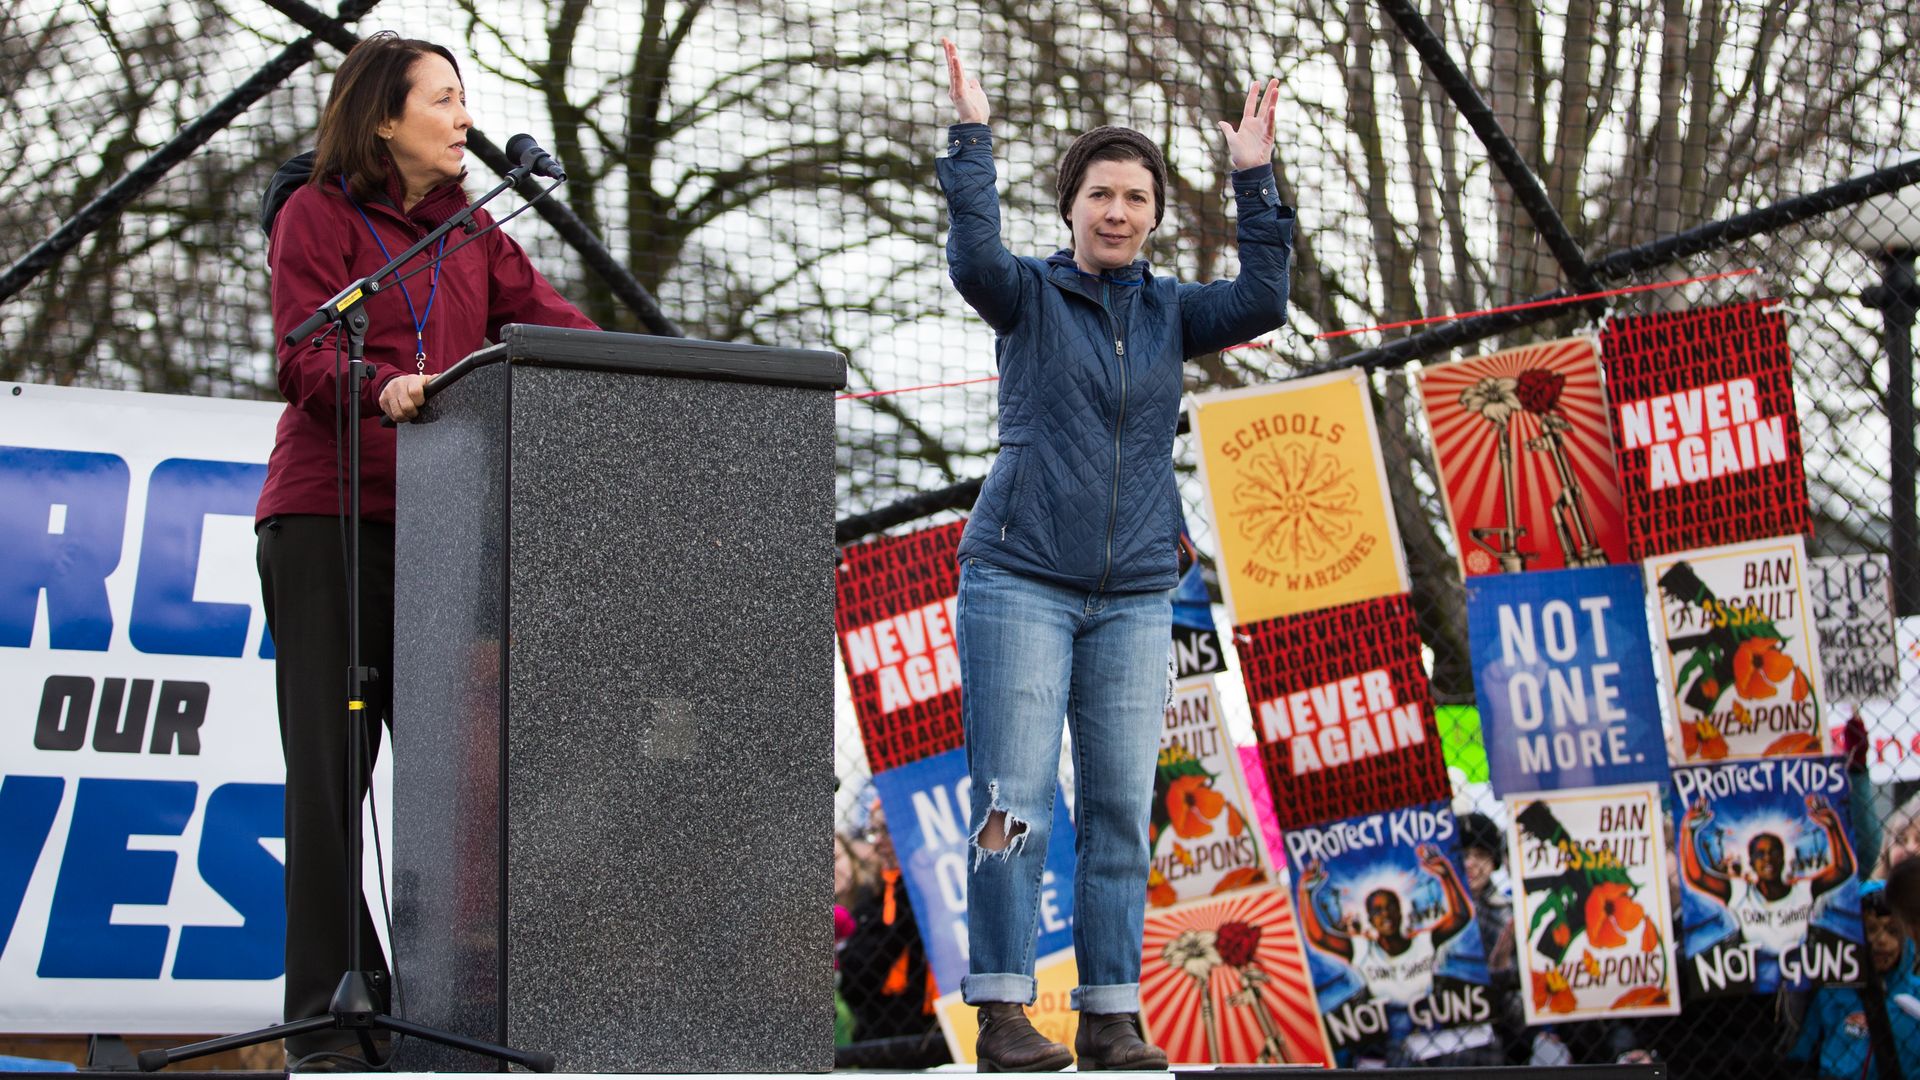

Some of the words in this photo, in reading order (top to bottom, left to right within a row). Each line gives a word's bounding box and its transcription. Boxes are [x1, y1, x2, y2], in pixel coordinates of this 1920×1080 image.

[1222, 413, 1346, 462] SCHOOLS
[1621, 377, 1760, 450] NEVER
[1650, 416, 1786, 491] AGAIN
[0, 445, 276, 658] RC
[1242, 559, 1280, 587] NOT
[1286, 541, 1377, 591] WARZONES
[1744, 557, 1792, 589] BAN
[1808, 559, 1881, 600] LIP
[1498, 596, 1611, 667] NOT
[1701, 588, 1797, 629] ASSAULT
[34, 674, 211, 756] OUR
[1259, 669, 1395, 743] NEVER
[1508, 662, 1627, 732] ONE
[1695, 702, 1812, 738] WEAPONS
[1290, 702, 1425, 776] AGAIN
[1517, 726, 1645, 775] MORE.
[1781, 759, 1845, 796] KIDS
[1389, 807, 1454, 848] KIDS
[1599, 804, 1647, 833] BAN
[1556, 836, 1651, 870] ASSAULT
[1545, 953, 1661, 990] WEAPONS
[1694, 943, 1759, 993] NOT
[1778, 939, 1860, 988] GUNS
[1326, 999, 1390, 1047] NOT
[1407, 984, 1491, 1030] GUNS
